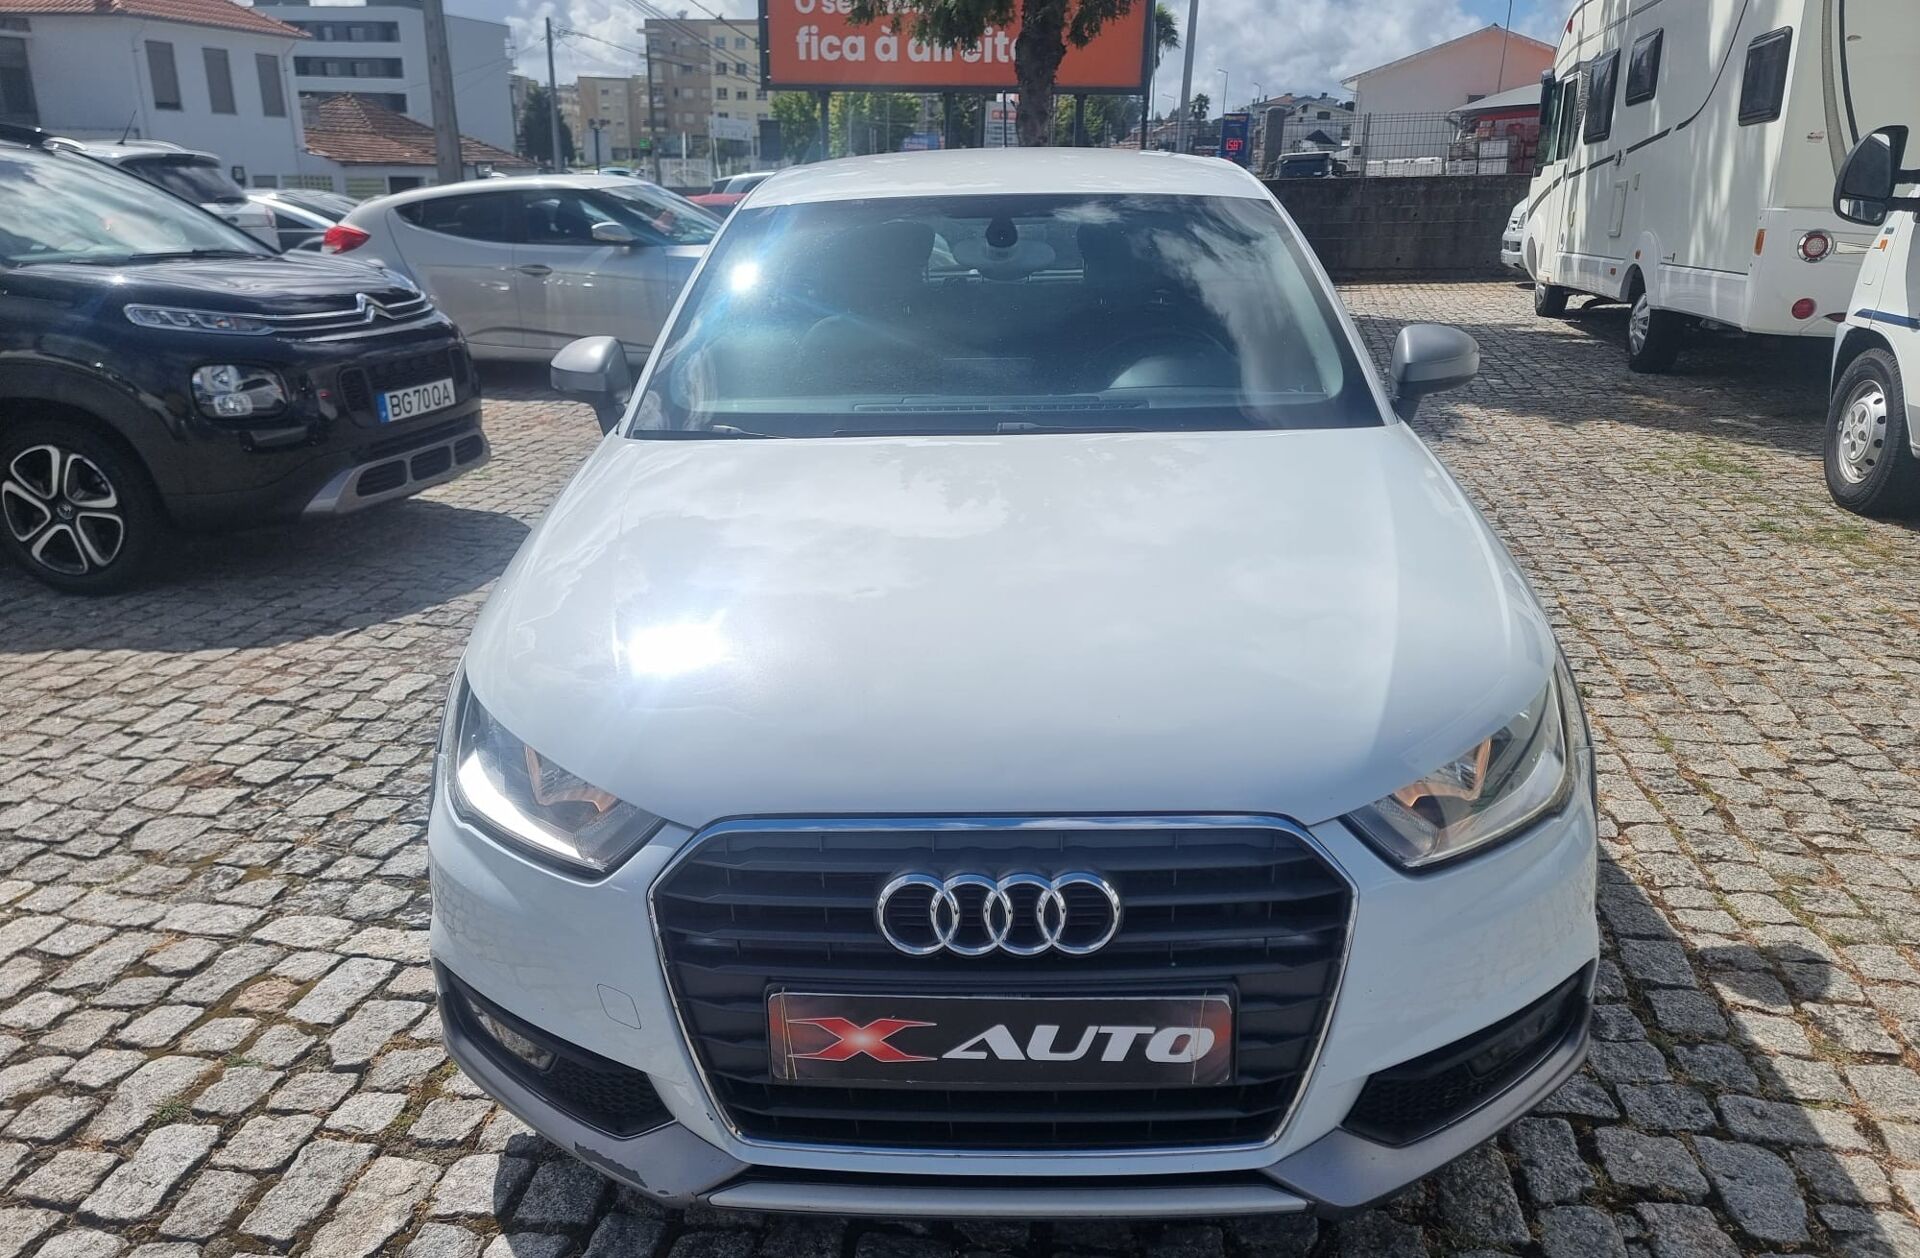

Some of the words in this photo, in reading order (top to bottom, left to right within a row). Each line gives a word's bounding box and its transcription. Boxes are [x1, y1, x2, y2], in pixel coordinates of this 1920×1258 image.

[796, 25, 865, 62] fica
[875, 26, 898, 62] à
[907, 26, 1017, 63] direit
[389, 383, 452, 417] BG70QA
[787, 1016, 938, 1062] X
[942, 1023, 1215, 1063] AUTO
